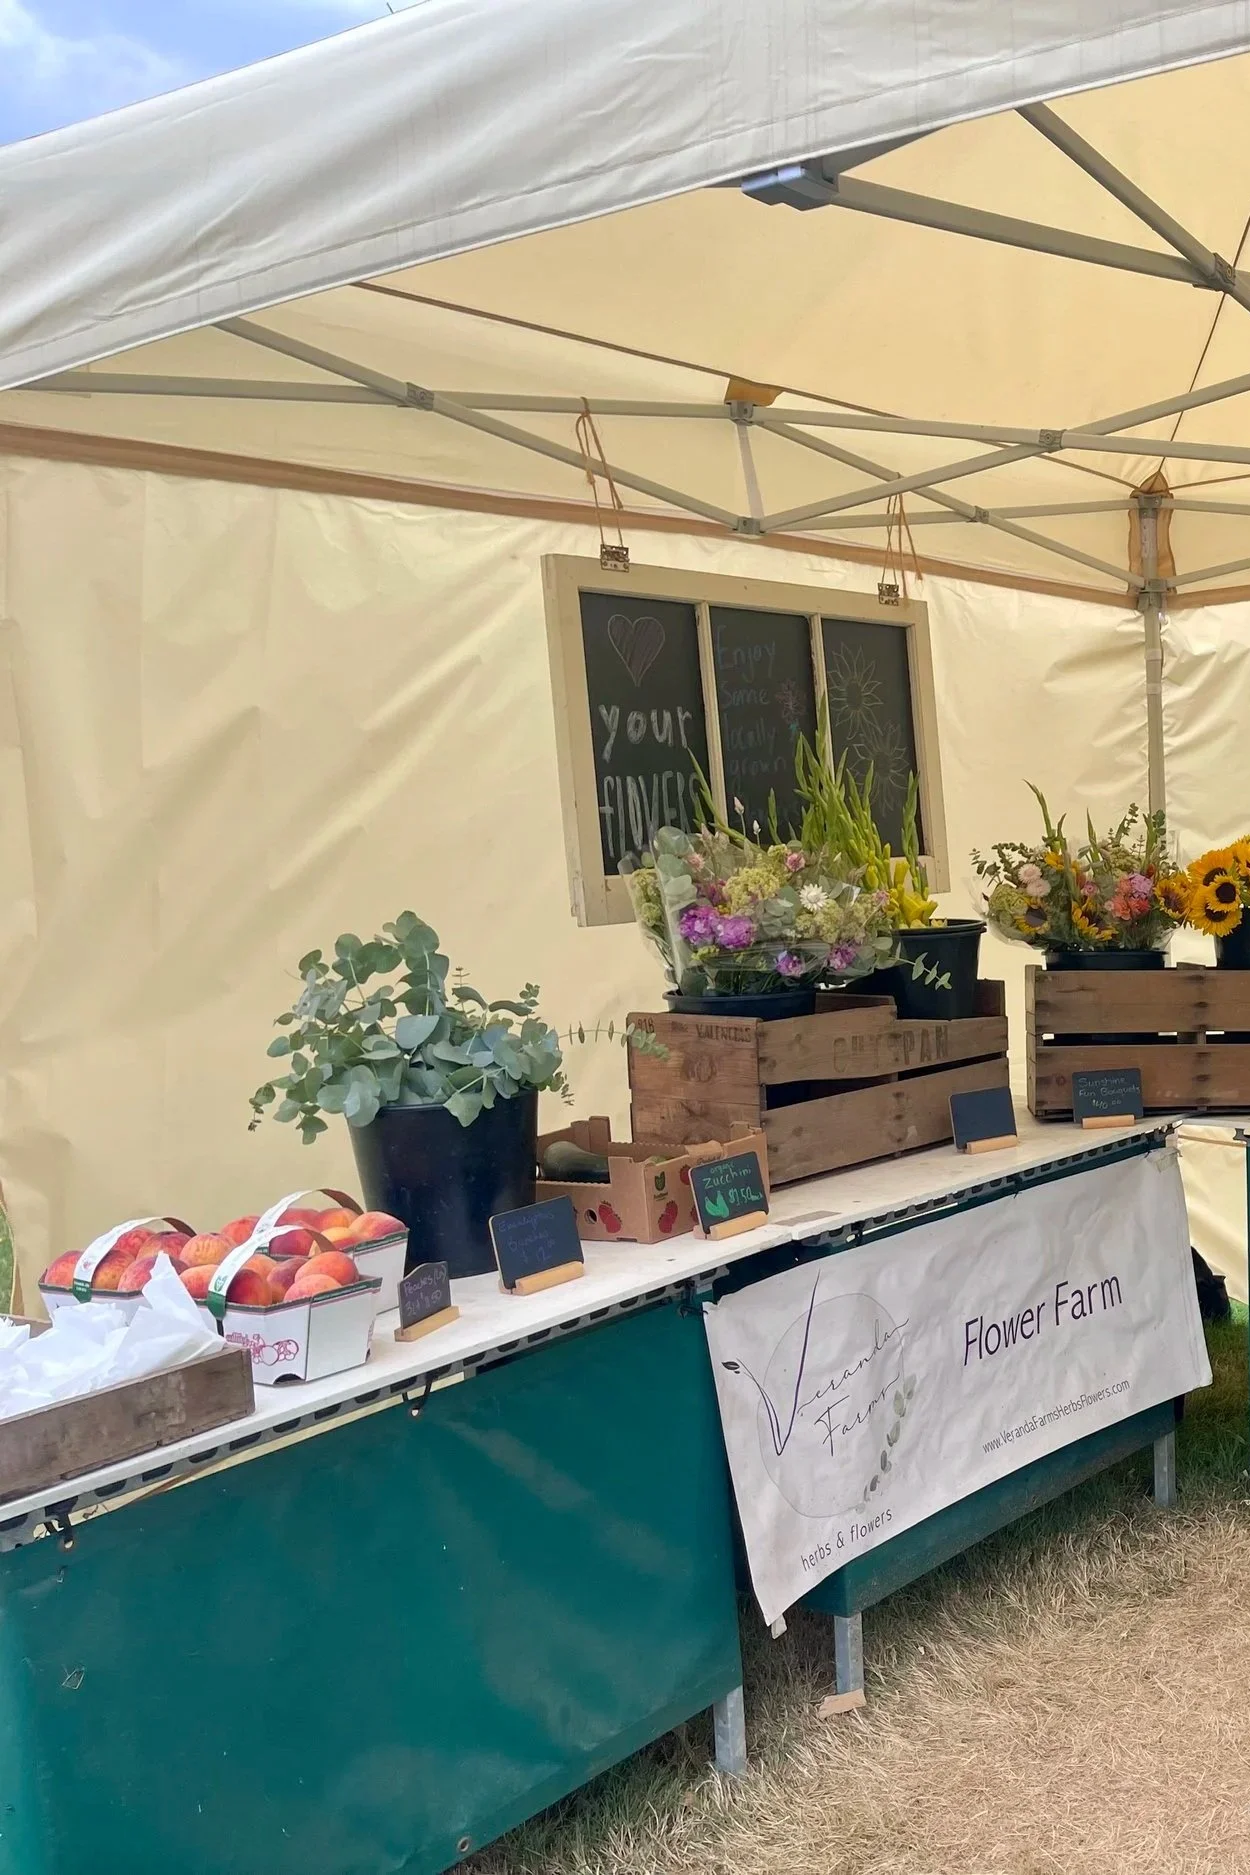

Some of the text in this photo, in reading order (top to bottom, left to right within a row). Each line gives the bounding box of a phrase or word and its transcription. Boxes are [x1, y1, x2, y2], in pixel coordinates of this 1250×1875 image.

[716, 625, 775, 682] Enjoy
[599, 705, 692, 763] your
[964, 1276, 1122, 1366] Flower Farm
[982, 1379, 1131, 1454] www.VerandaFarmsHerbsFlowers.com
[801, 1508, 893, 1572] herbs & flowers
